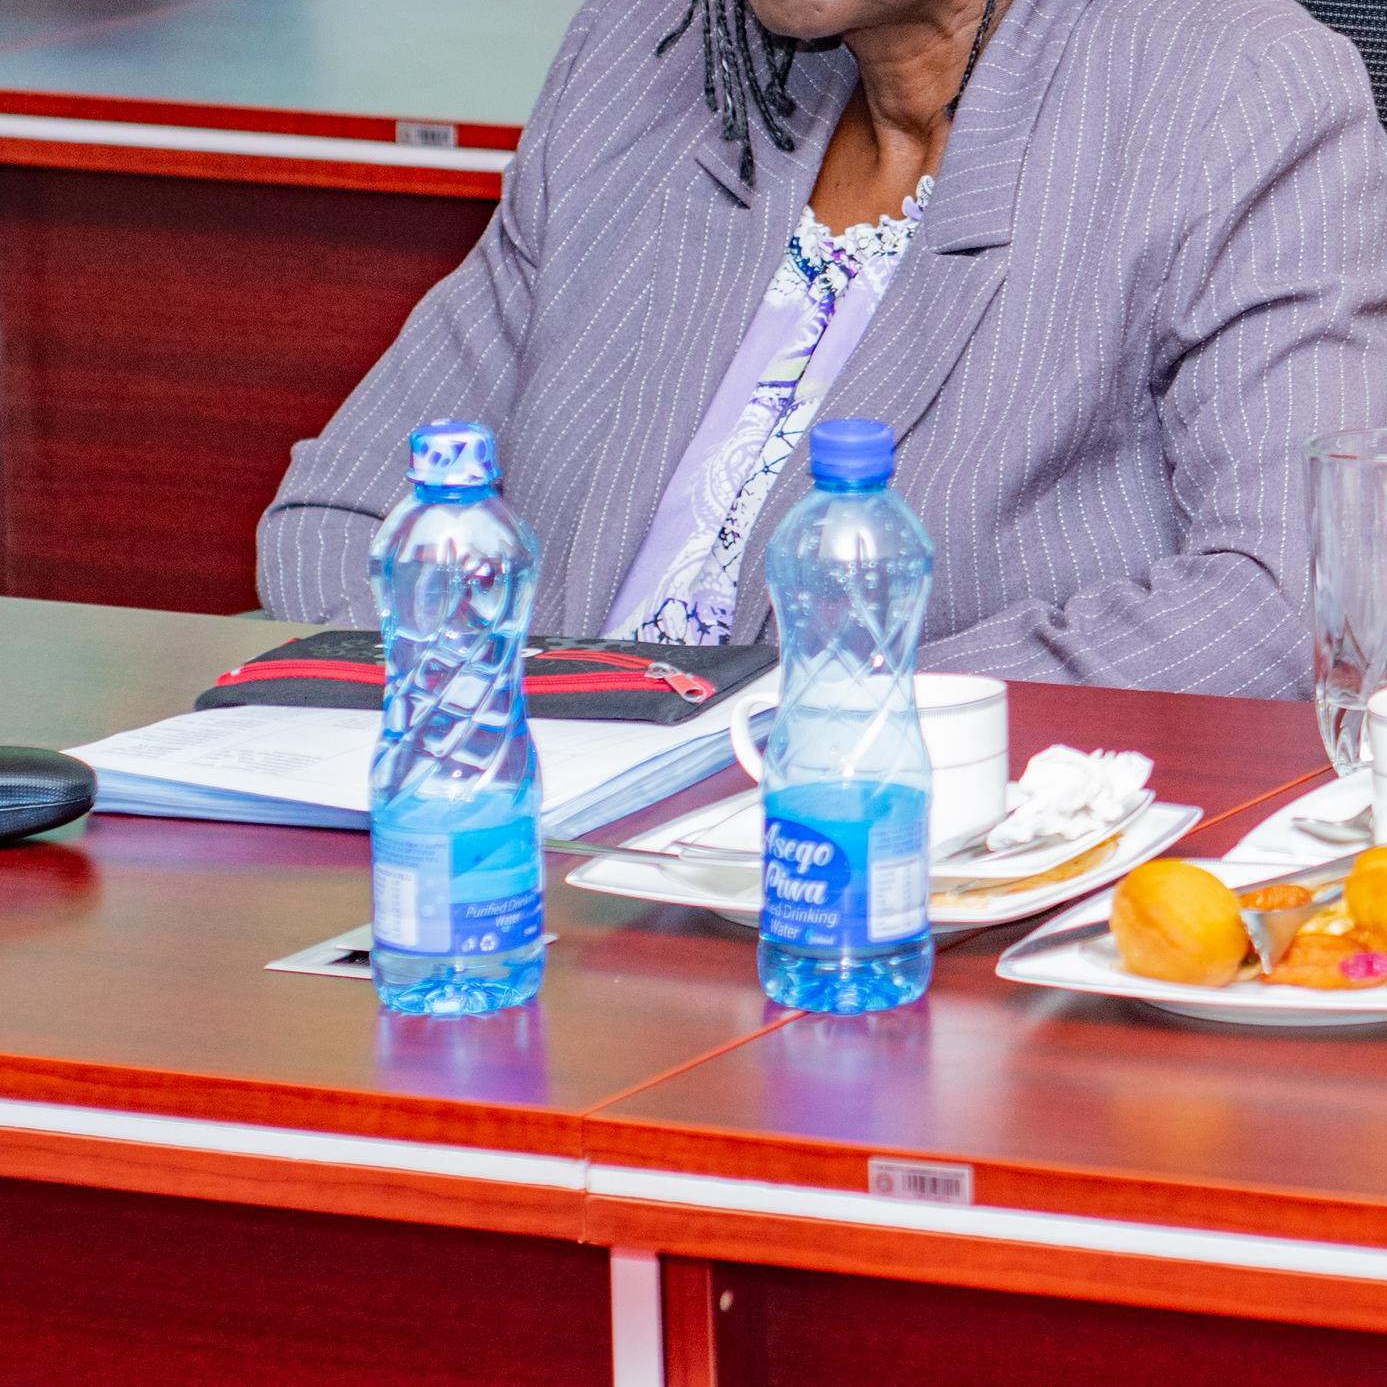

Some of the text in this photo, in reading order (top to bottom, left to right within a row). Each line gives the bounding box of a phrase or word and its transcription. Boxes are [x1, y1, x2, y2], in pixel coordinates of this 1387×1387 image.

[765, 860, 829, 905] Piwa
[465, 901, 508, 919] Purified
[496, 912, 520, 927] Water
[784, 905, 838, 928] Drinking
[770, 919, 799, 939] Water
